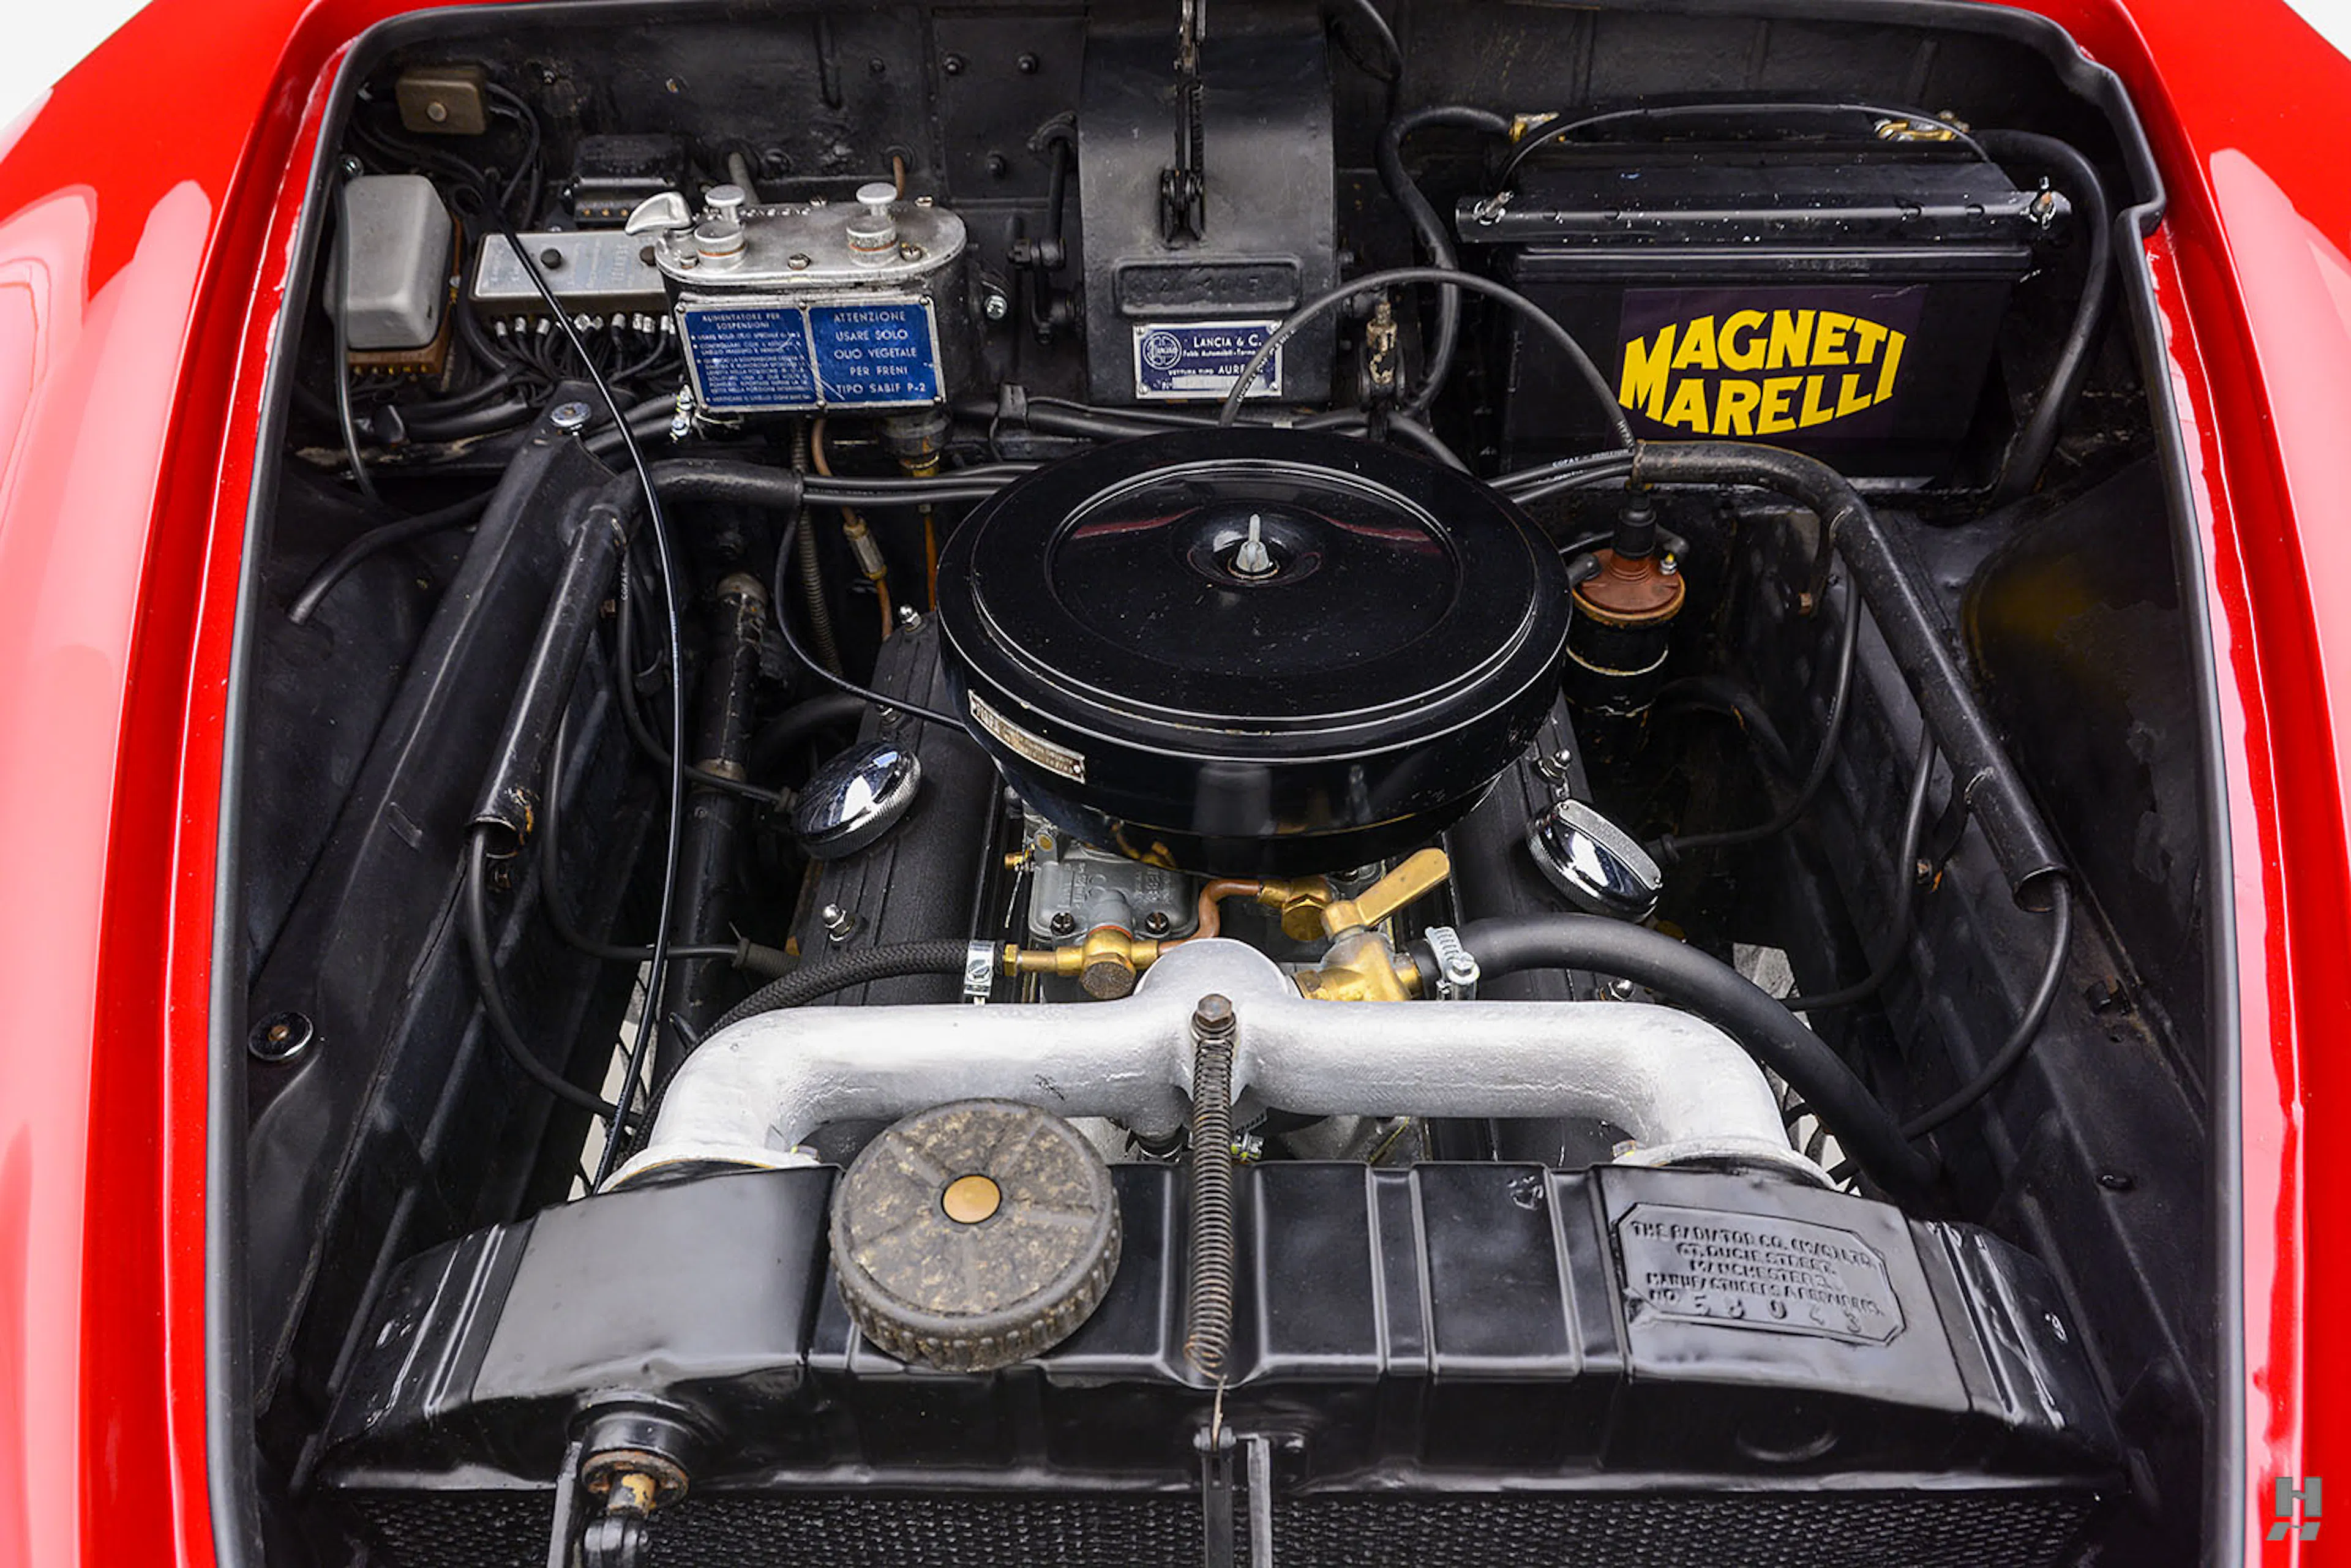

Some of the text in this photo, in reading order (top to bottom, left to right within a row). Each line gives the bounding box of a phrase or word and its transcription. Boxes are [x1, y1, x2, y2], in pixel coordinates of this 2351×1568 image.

[834, 311, 906, 323] ATTENZIONE
[716, 321, 770, 331] SOSPENSIONI
[835, 328, 909, 342] USARE SOLO
[1194, 336, 1232, 348] LANCIA
[1237, 336, 1245, 347] &
[834, 347, 917, 360] OLIO VEGETALE
[1619, 309, 1907, 404] MAGNETI
[850, 366, 908, 377] PER FRENI
[836, 382, 926, 394] TIPO SABIF P-2
[1618, 367, 1894, 436] MARELLI
[1631, 1221, 1670, 1239] THE
[1670, 1225, 1755, 1246] RADIATOR
[1706, 1245, 1763, 1262] DUCIE
[1690, 1259, 1813, 1286] MANCHESTER
[1646, 1272, 1780, 1297] MANUFACTURERS
